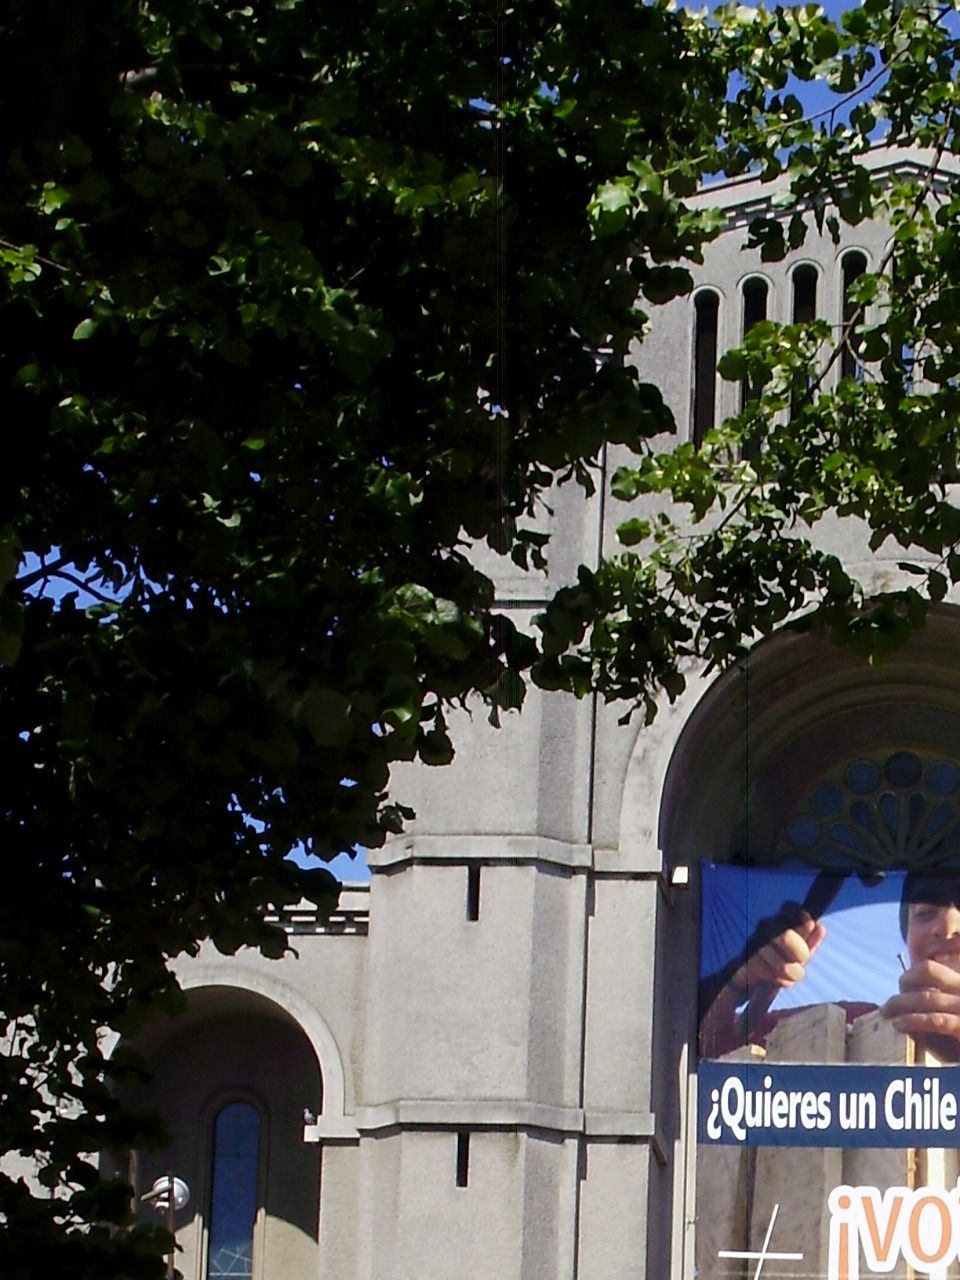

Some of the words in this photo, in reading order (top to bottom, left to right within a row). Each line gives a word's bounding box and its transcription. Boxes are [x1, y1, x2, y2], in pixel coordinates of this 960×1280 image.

[706, 1075, 832, 1141] ¿Quieres
[839, 1092, 877, 1130] un
[884, 1077, 957, 1131] Chile
